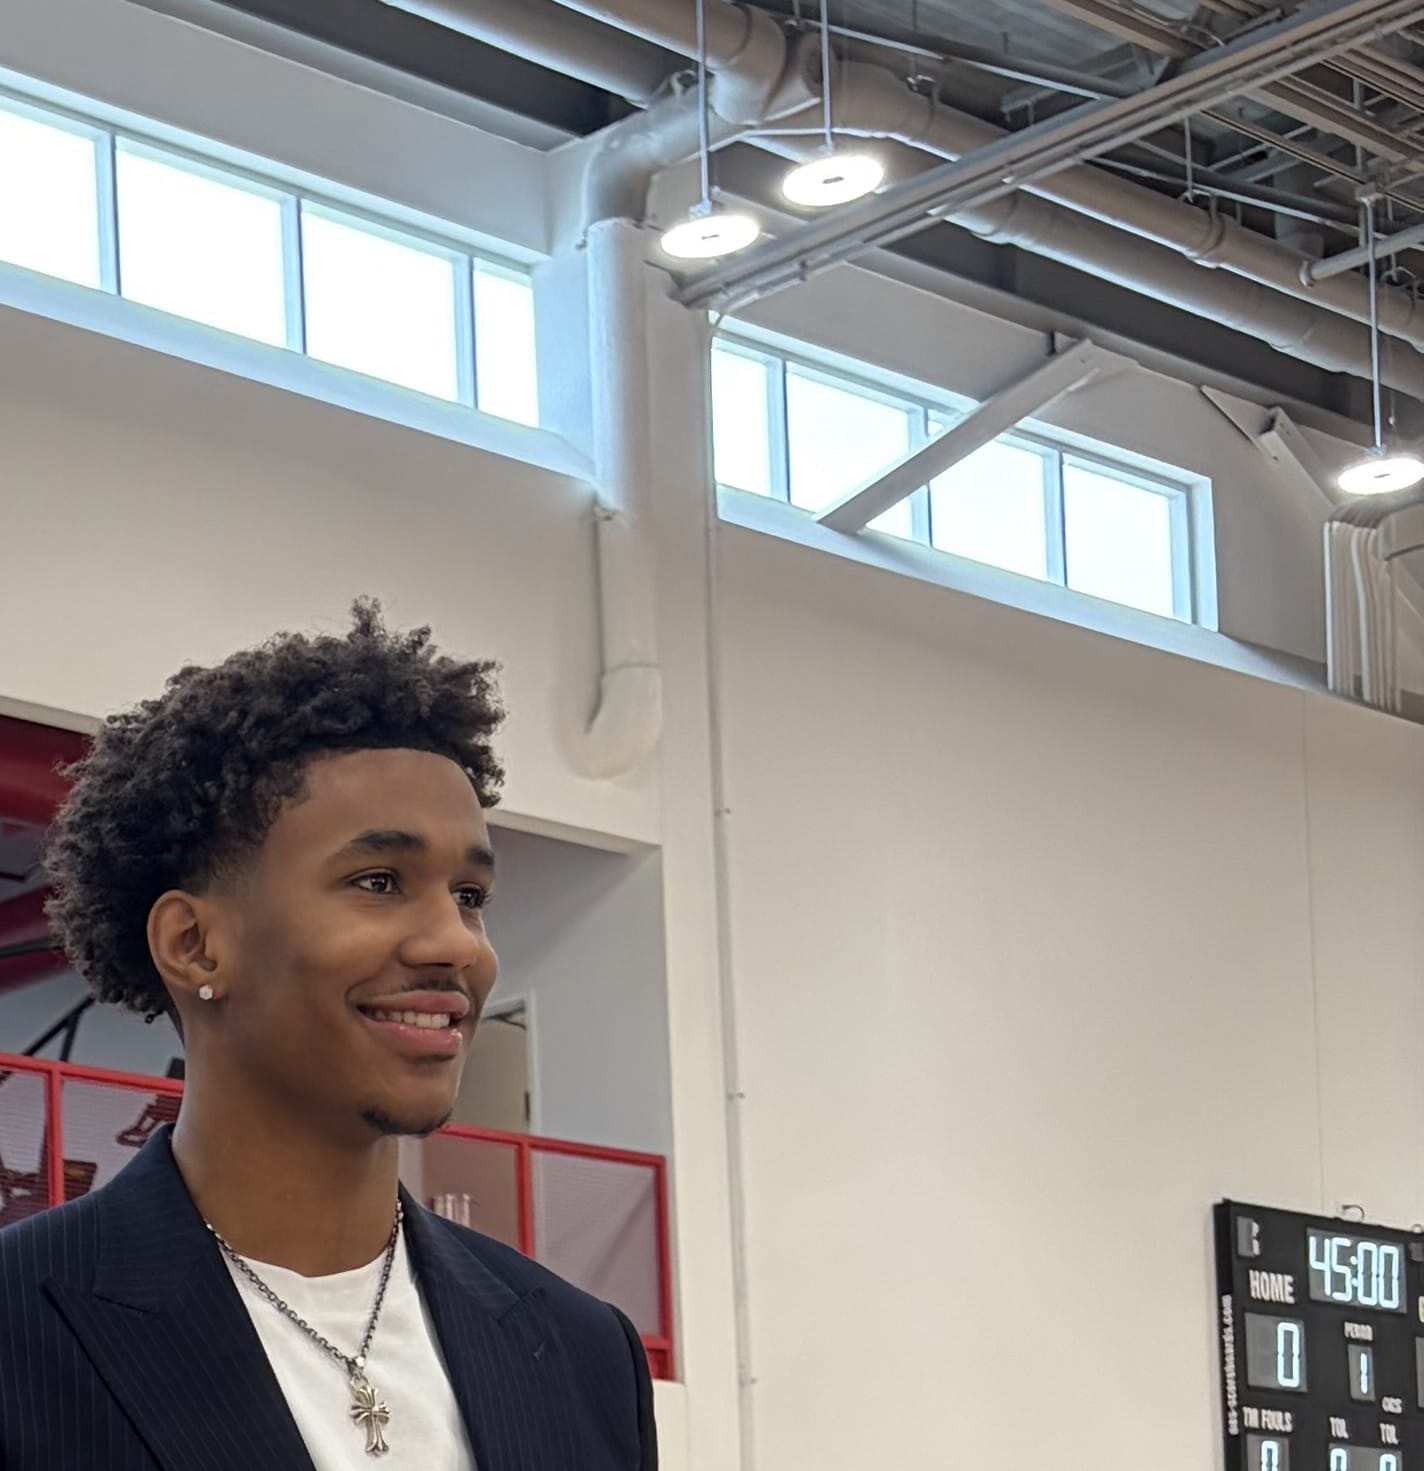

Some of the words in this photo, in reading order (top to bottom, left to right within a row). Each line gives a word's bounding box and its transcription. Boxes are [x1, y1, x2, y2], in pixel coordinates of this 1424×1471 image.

[1249, 1270, 1296, 1304] HOME
[1309, 1236, 1400, 1310] 45:00
[1277, 1322, 1300, 1388] 0
[1360, 1352, 1368, 1394] 1
[1261, 1409, 1293, 1432] FOULS
